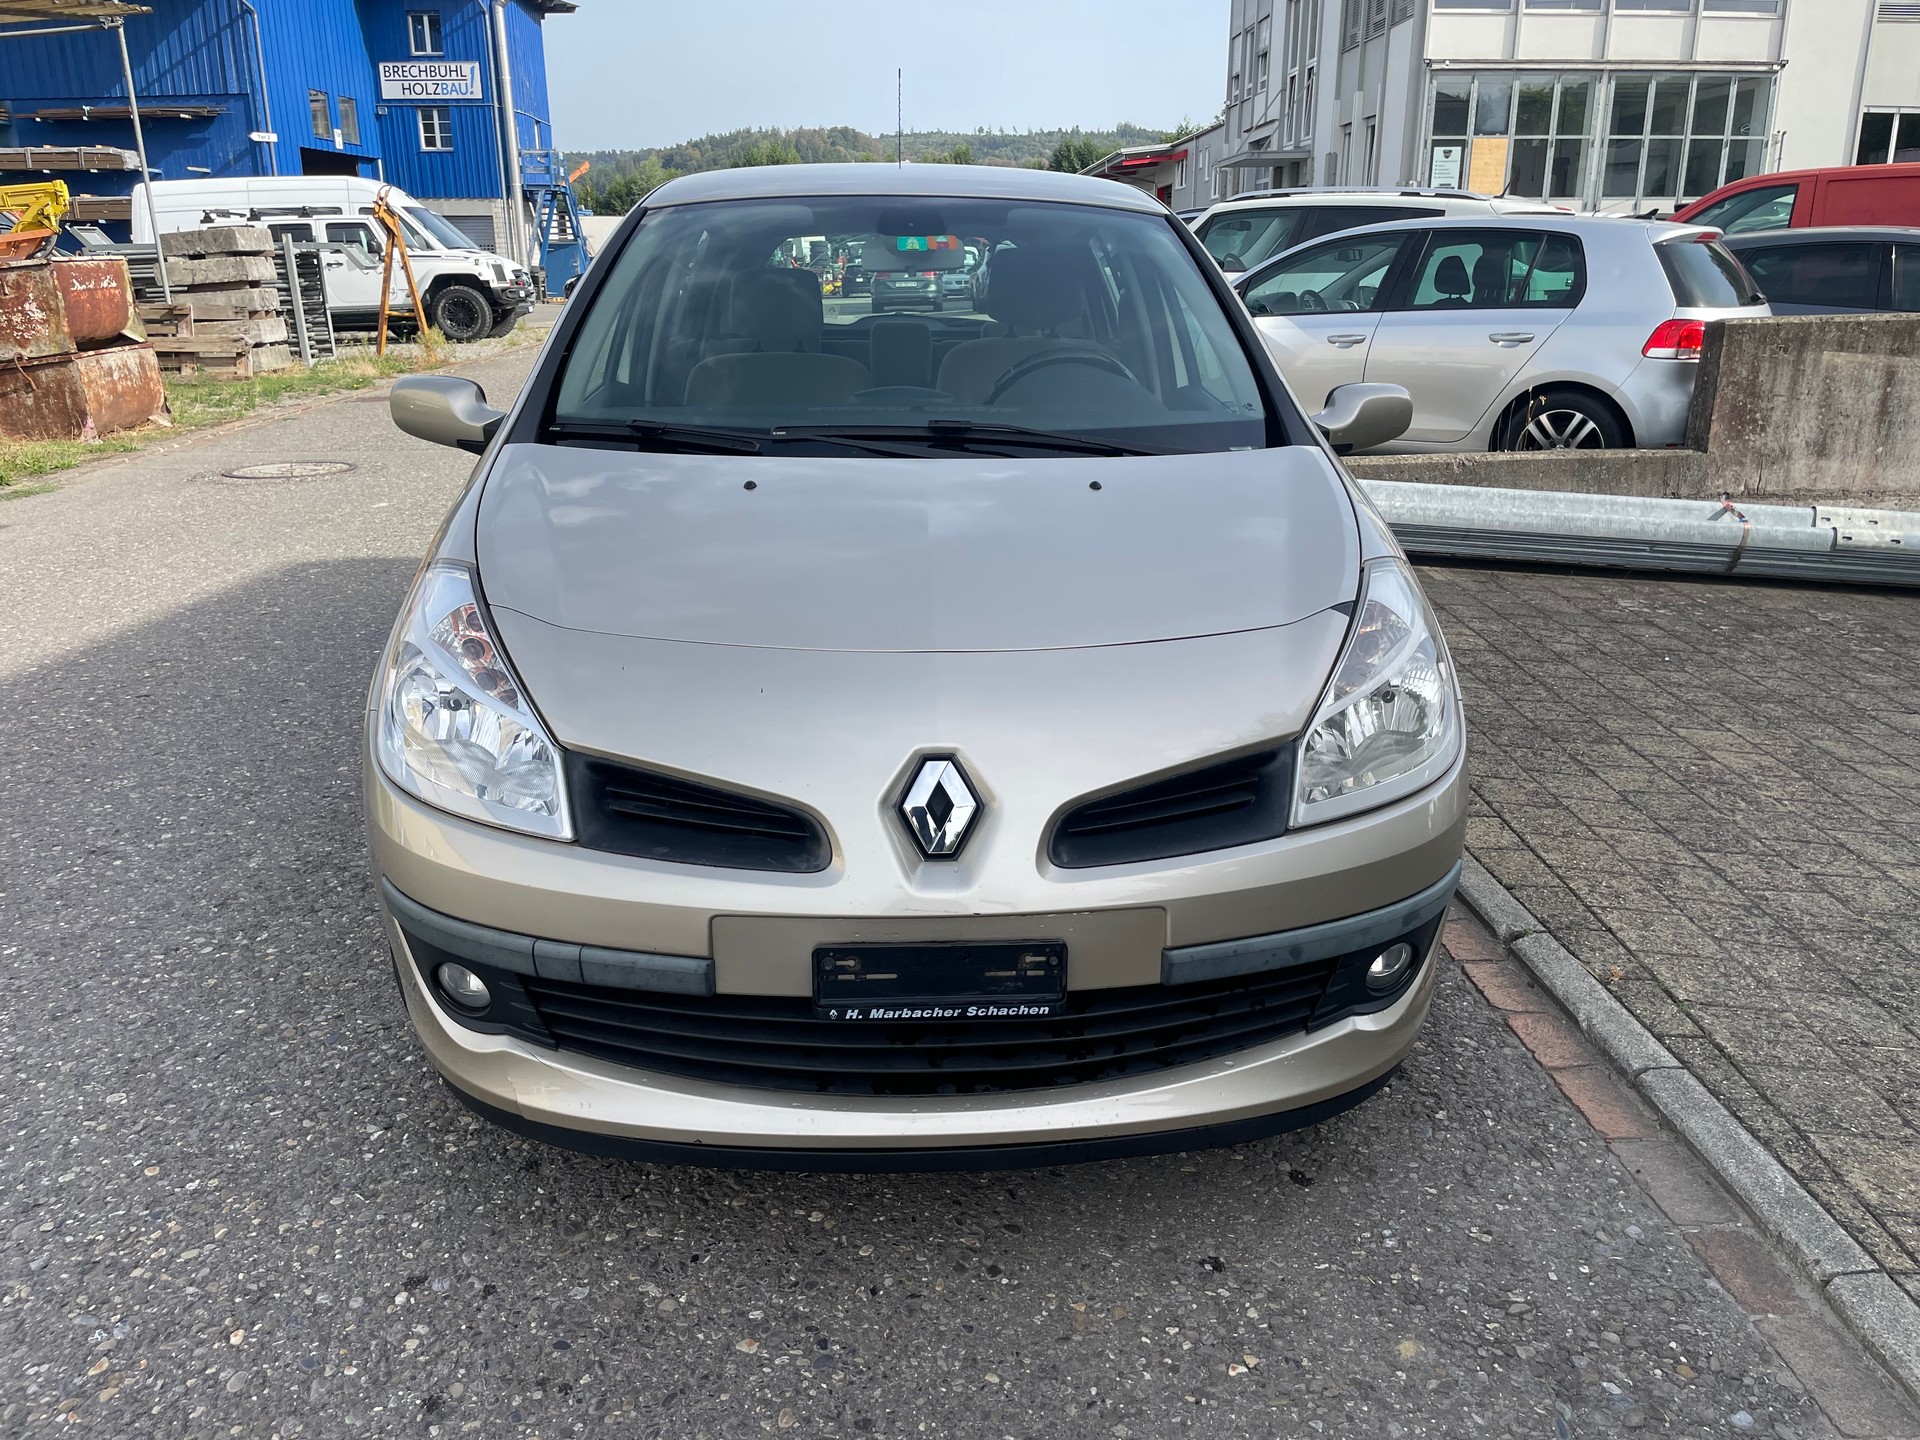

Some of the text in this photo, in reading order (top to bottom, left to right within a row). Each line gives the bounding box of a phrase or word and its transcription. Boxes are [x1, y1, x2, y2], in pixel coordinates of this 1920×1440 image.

[383, 65, 467, 78] BRECHBÜHL
[845, 1005, 1050, 1020] H. Marbacher Schachen
